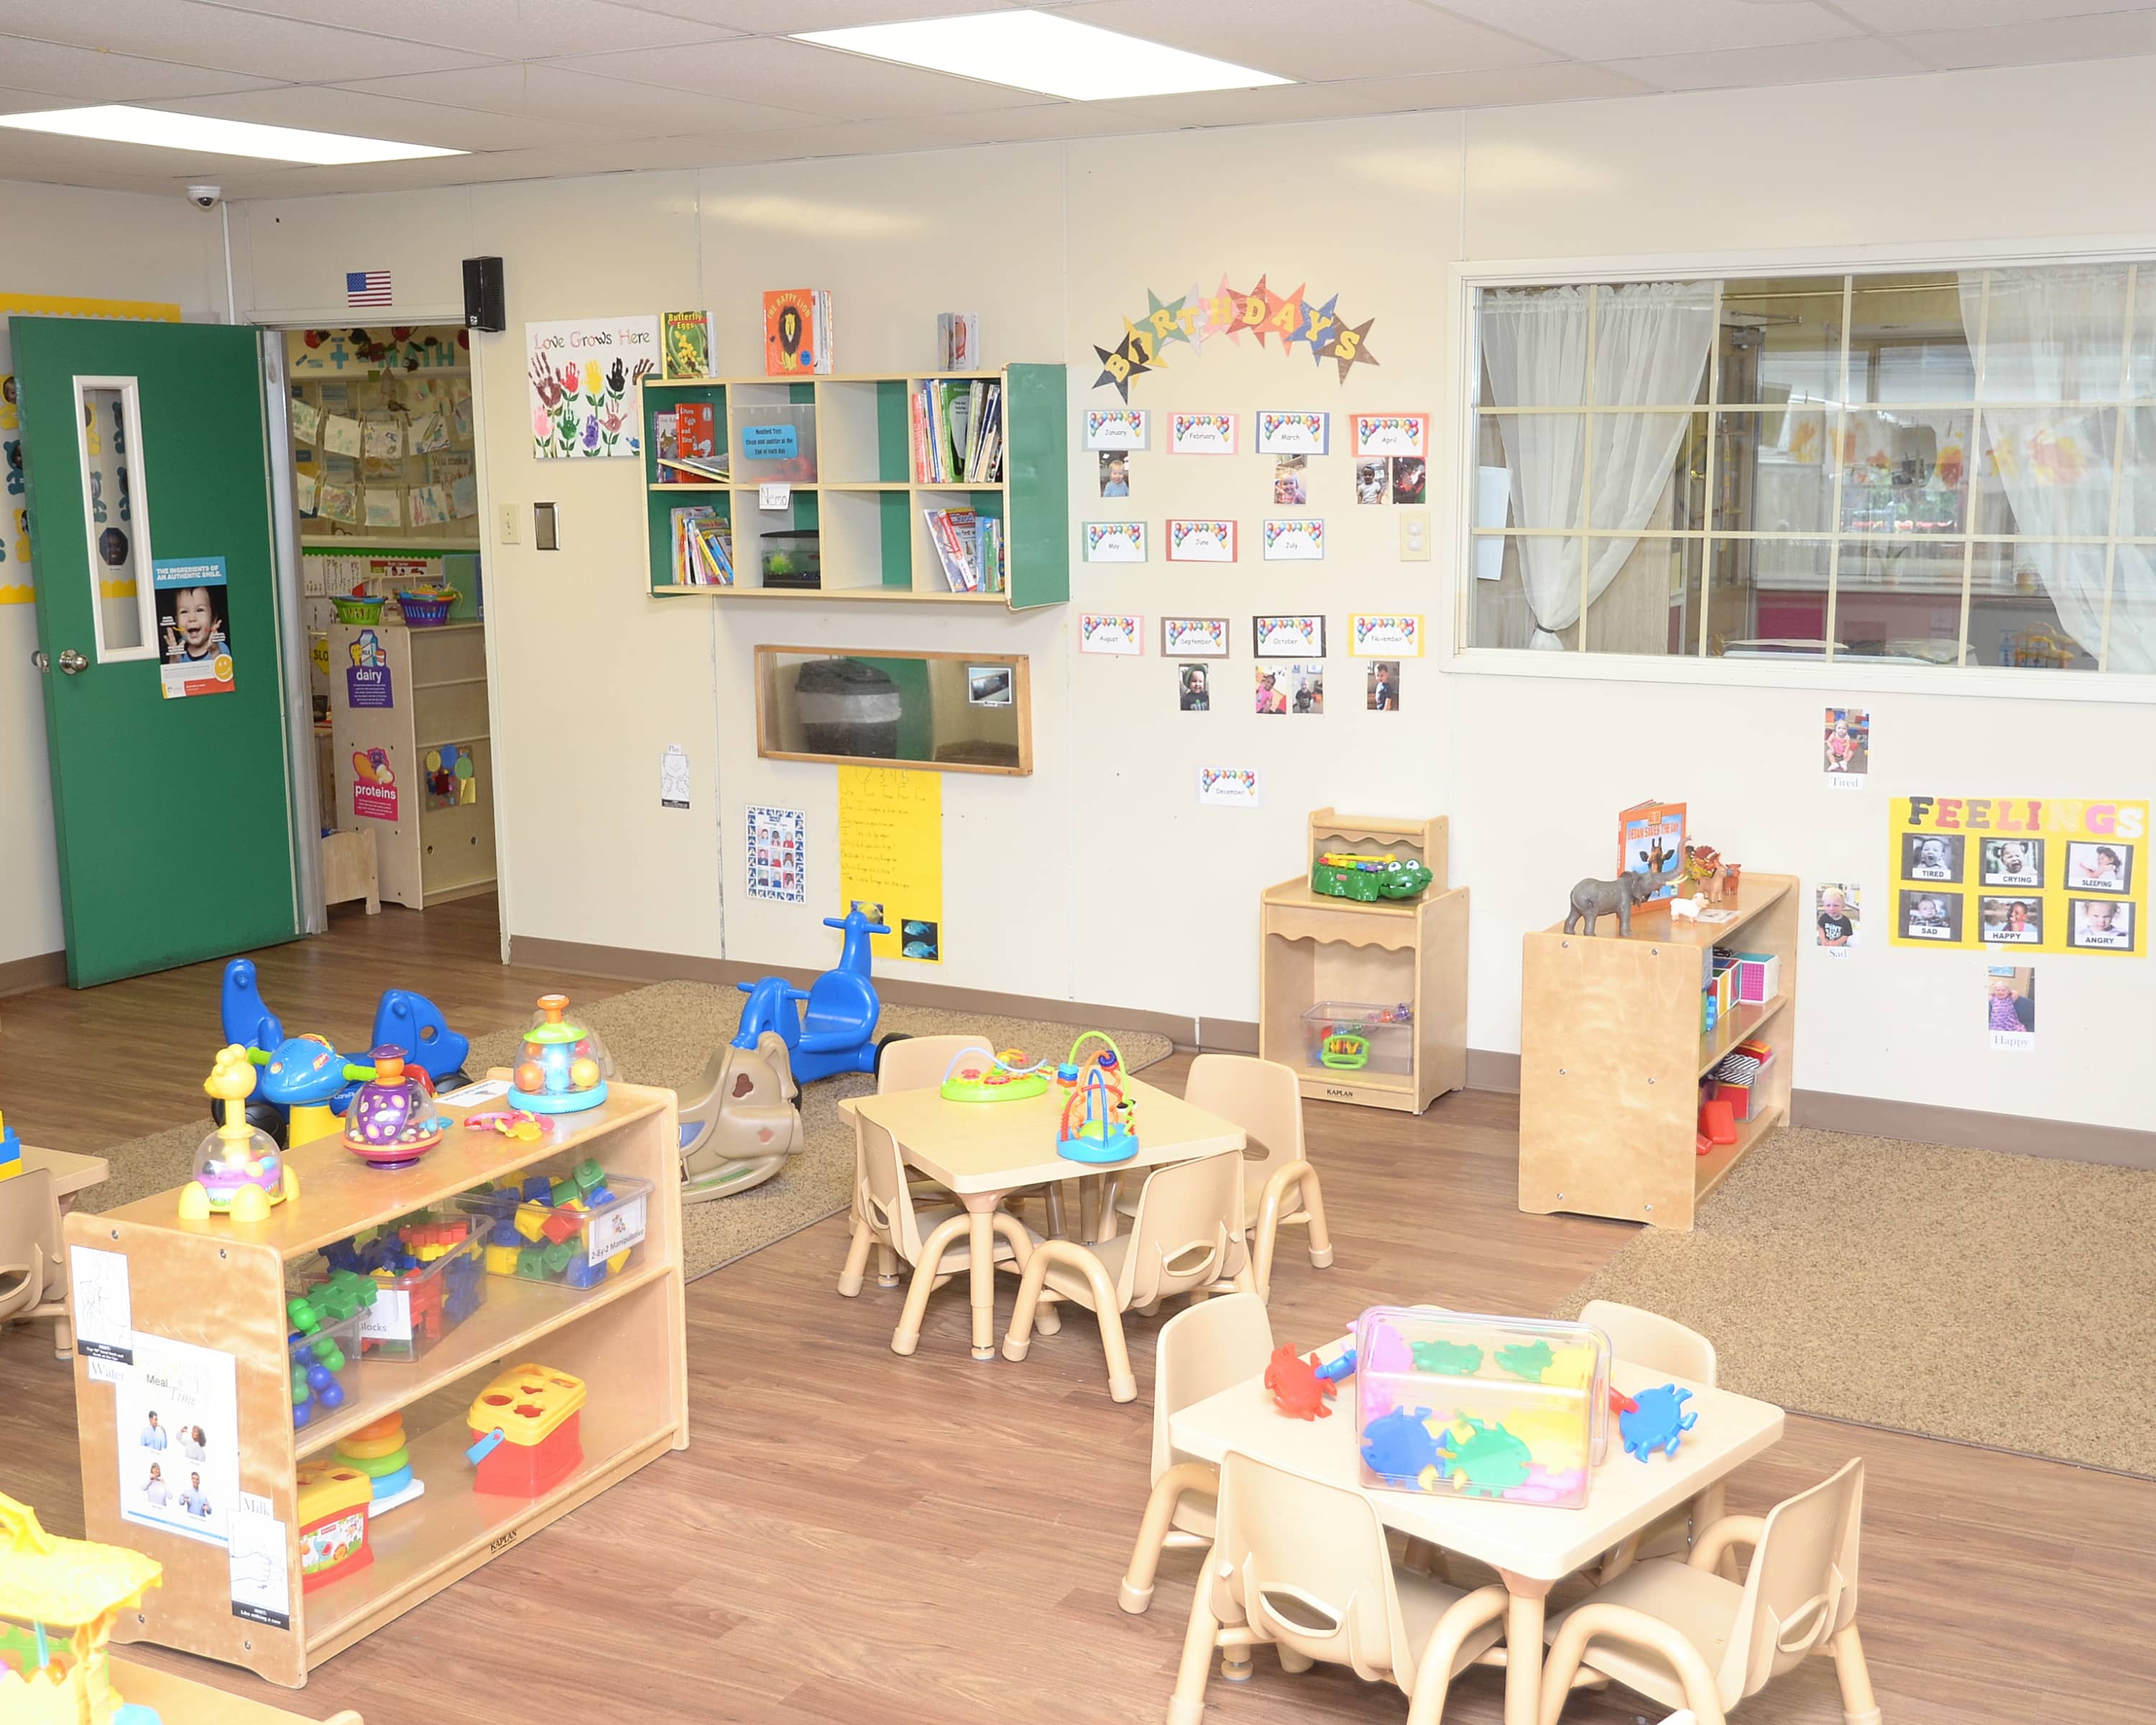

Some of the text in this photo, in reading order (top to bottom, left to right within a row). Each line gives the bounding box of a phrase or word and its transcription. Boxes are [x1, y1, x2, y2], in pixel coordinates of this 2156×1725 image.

[768, 293, 811, 319] THE HAPPY LION
[668, 313, 702, 322] Butterfly
[534, 329, 650, 349] Love Grows Here
[1105, 297, 1360, 383] BIRTHDAYS
[1104, 429, 1127, 438] January
[1189, 432, 1216, 441] February
[760, 487, 788, 506] Nemo
[170, 566, 209, 574] INGREDIENTS
[1180, 638, 1212, 646] September
[314, 650, 329, 661] SLO
[356, 668, 382, 684] dairy
[865, 768, 872, 781] 2
[1830, 776, 1859, 788] Tired
[355, 785, 396, 799] proteins
[1908, 796, 2144, 839] FEELINGS
[1644, 824, 1660, 838] SAVES
[1661, 823, 1670, 835] THE
[1921, 870, 1945, 878] TIRED
[2002, 875, 2032, 884] CRYING
[2081, 879, 2113, 888] SLEEPING
[1921, 927, 1938, 936] SAD
[2085, 937, 2115, 945] ANGRY
[1829, 948, 1847, 958] Sad
[1994, 1034, 2030, 1047] Happy
[1327, 1088, 1353, 1097] KAPLAN
[361, 1323, 387, 1332] locks
[92, 1362, 124, 1380] Water
[147, 1374, 168, 1388] Meal
[169, 1385, 196, 1406] Time
[244, 1497, 270, 1517] Milk
[490, 1529, 517, 1550] KAPLAN
